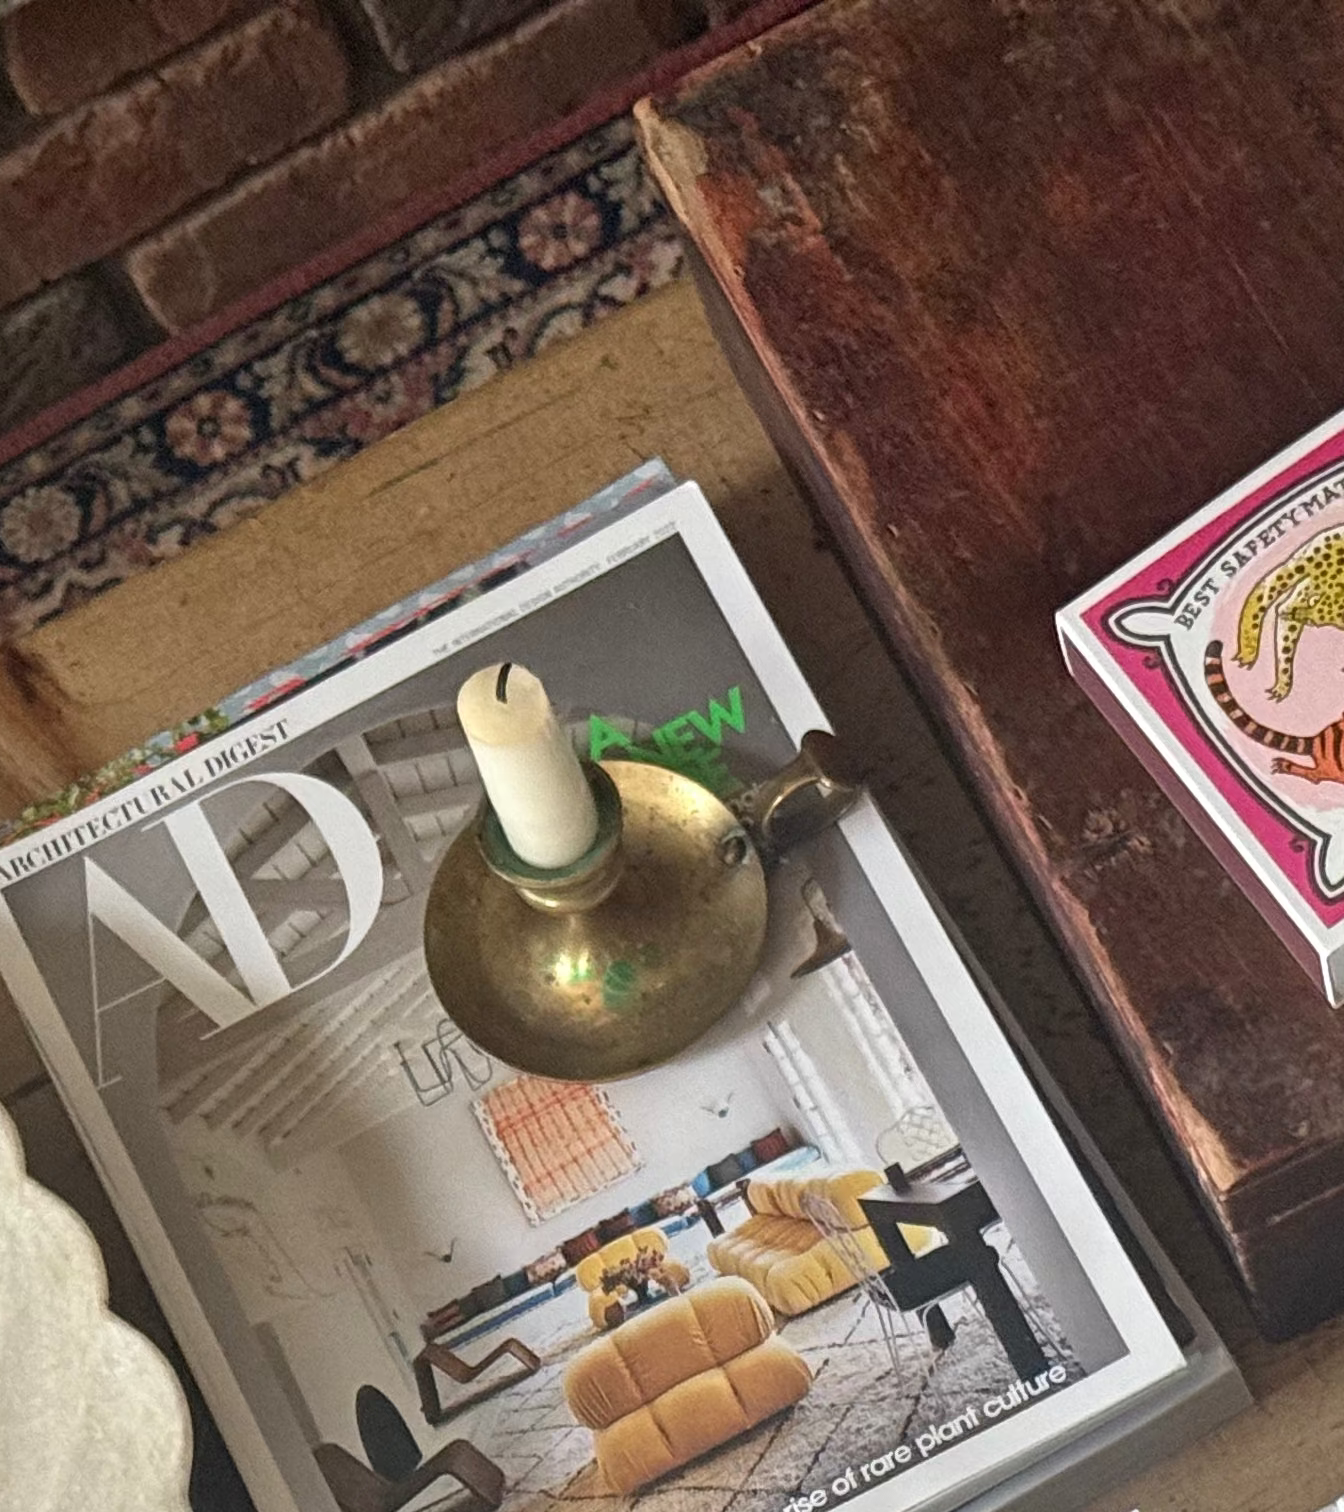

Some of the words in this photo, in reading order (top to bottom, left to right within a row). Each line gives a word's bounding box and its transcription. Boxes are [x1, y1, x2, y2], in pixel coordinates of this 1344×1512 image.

[1174, 578, 1222, 631] BEST
[1220, 506, 1303, 578] SAFETY
[206, 718, 289, 778] DIGEST
[589, 714, 633, 762] A
[84, 772, 384, 1091] AD
[831, 1467, 859, 1496] of
[860, 1444, 912, 1483] rare
[915, 1406, 980, 1458] plant
[983, 1364, 1067, 1418] culture
